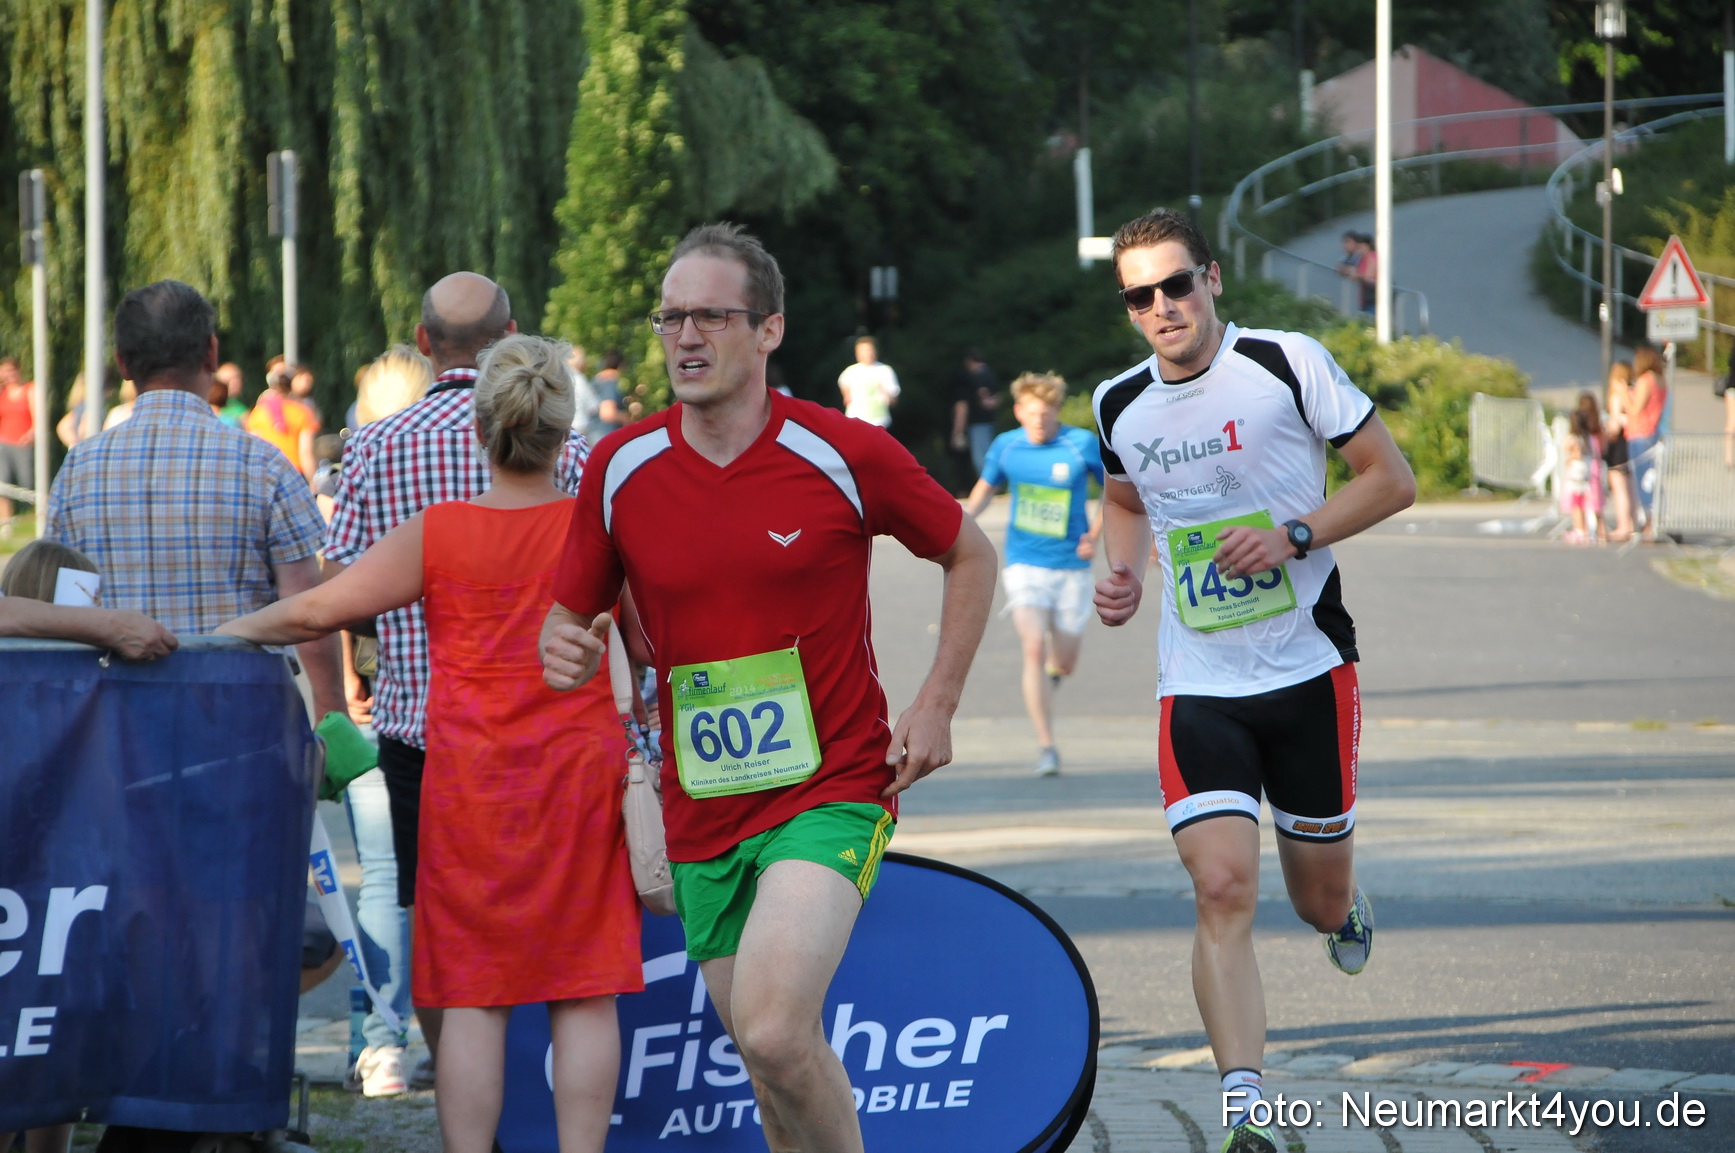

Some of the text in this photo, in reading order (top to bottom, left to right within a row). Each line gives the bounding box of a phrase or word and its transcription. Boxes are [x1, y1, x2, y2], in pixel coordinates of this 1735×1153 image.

[1159, 483, 1215, 500] SPORTGEIST
[1208, 596, 1260, 614] Thomas Schmidt
[1236, 607, 1256, 618] GmbH
[689, 682, 727, 697] firmenlauf
[691, 701, 792, 763] 602
[720, 758, 771, 773] Ulrich Reiser
[690, 778, 717, 787] Kliniken
[718, 776, 730, 784] des
[730, 770, 773, 783] Landkreises
[773, 762, 809, 775] Neumarkt
[1197, 798, 1240, 809] acquatico
[624, 1003, 1009, 1100] Fisher
[658, 1079, 975, 1140] AUTBILE
